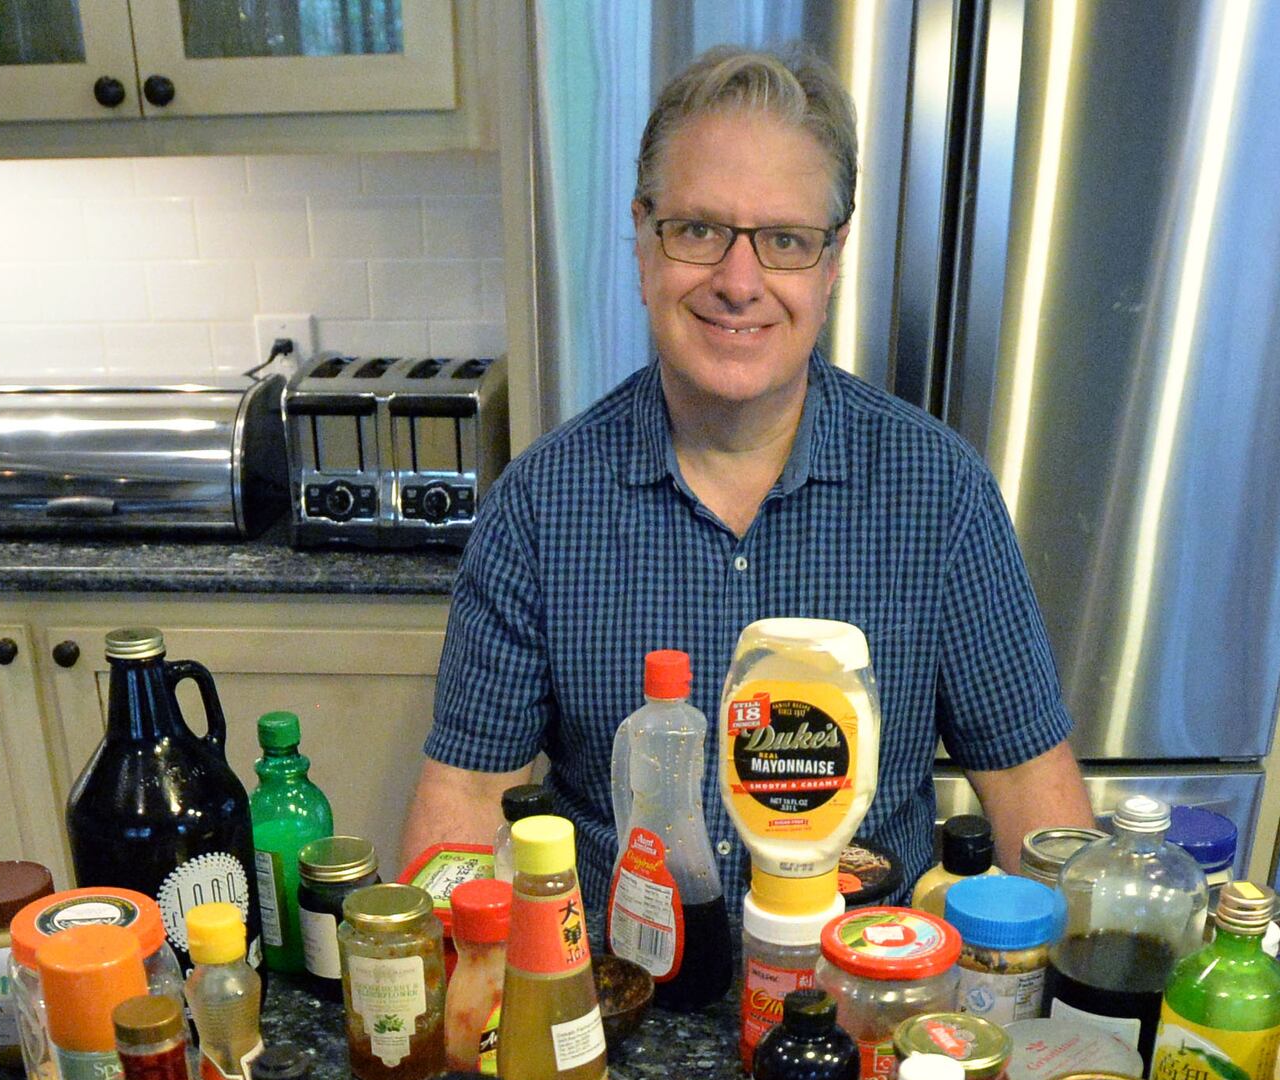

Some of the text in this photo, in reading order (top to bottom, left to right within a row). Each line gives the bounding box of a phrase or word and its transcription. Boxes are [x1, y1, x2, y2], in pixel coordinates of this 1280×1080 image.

[735, 708, 761, 721] 18
[742, 721, 841, 752] Duke's
[751, 758, 835, 775] MAYONNAISE
[750, 782, 788, 790] SMOOTH
[801, 780, 839, 789] CREAMY
